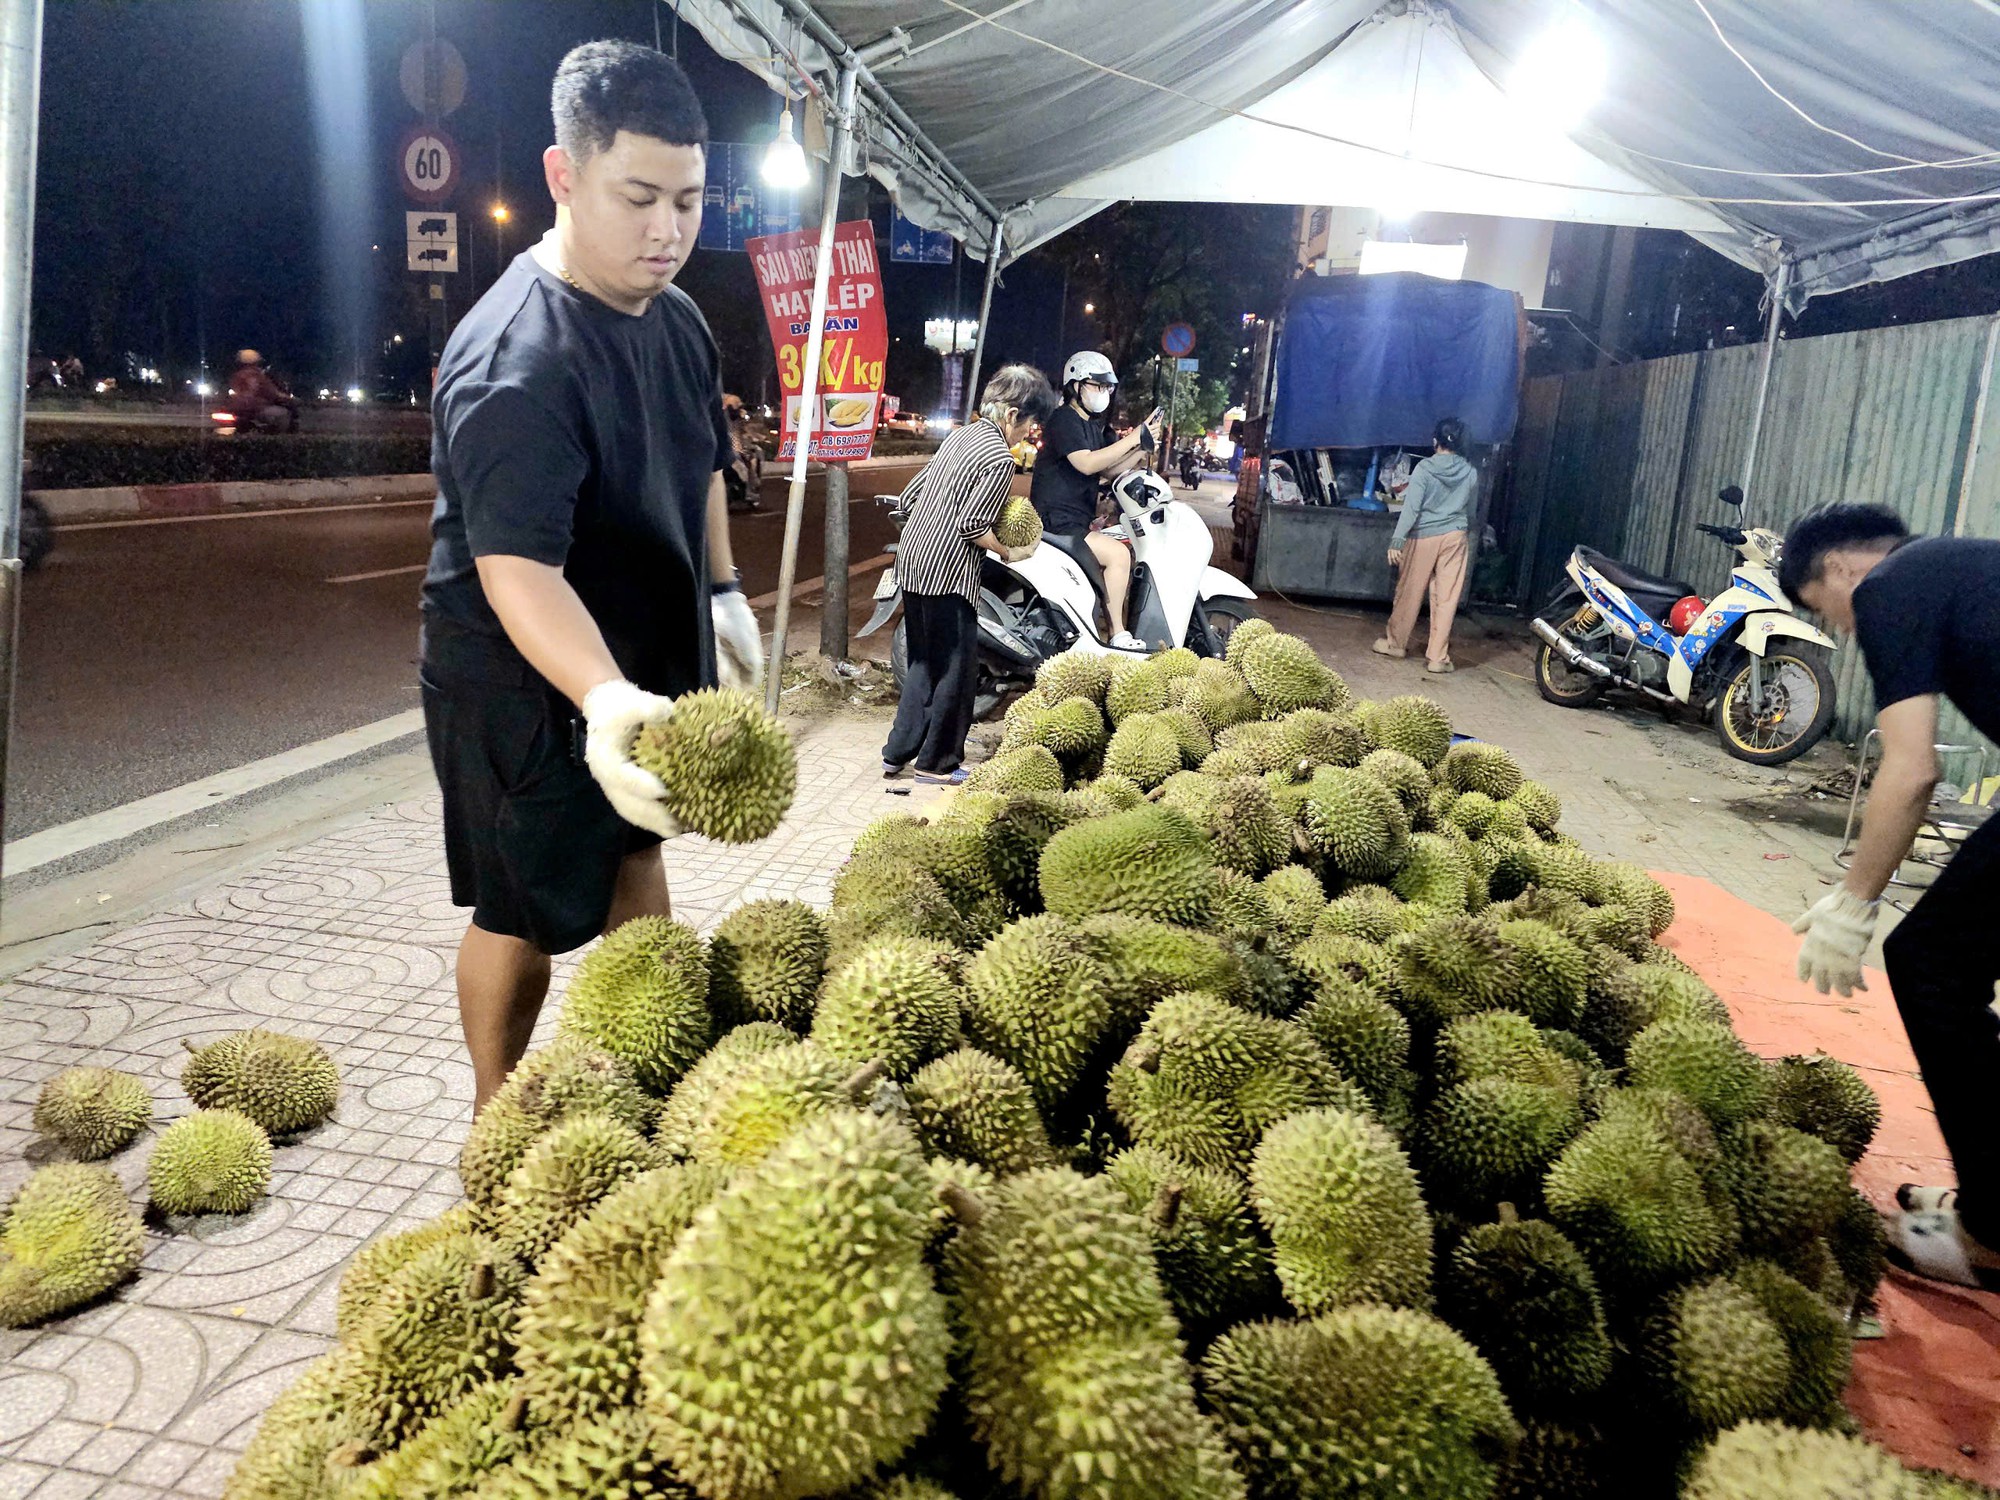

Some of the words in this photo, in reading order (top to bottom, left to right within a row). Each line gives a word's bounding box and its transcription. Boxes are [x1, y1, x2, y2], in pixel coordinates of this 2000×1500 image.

[415, 148, 441, 180] 60
[756, 242, 790, 286] SẦU
[788, 239, 835, 282] RIÊN
[835, 231, 875, 276] THÁI
[789, 320, 811, 337] BA
[824, 315, 860, 332] ĂN
